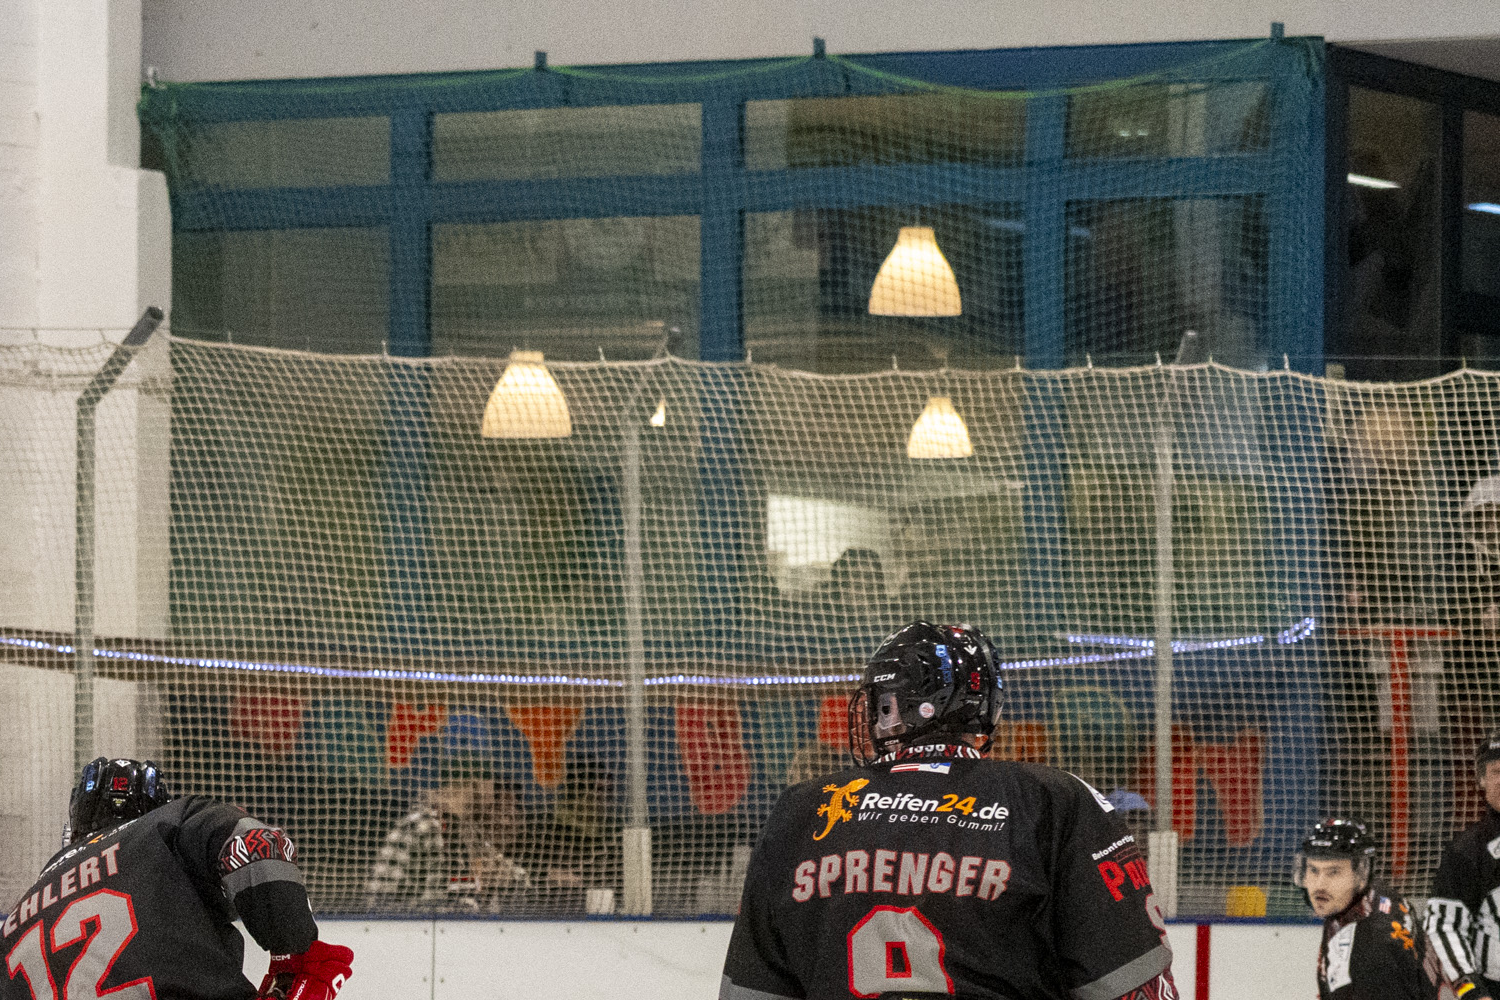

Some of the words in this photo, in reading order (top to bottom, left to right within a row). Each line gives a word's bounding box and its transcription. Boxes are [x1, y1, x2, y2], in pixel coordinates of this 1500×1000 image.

[874, 673, 896, 683] CCM
[860, 792, 1009, 820] Reifen24.de
[858, 811, 882, 822] Wir
[888, 813, 939, 824] geben
[947, 814, 1005, 831] Gummi!
[792, 849, 1011, 902] SPRENGER
[3, 843, 120, 938] EHLERT
